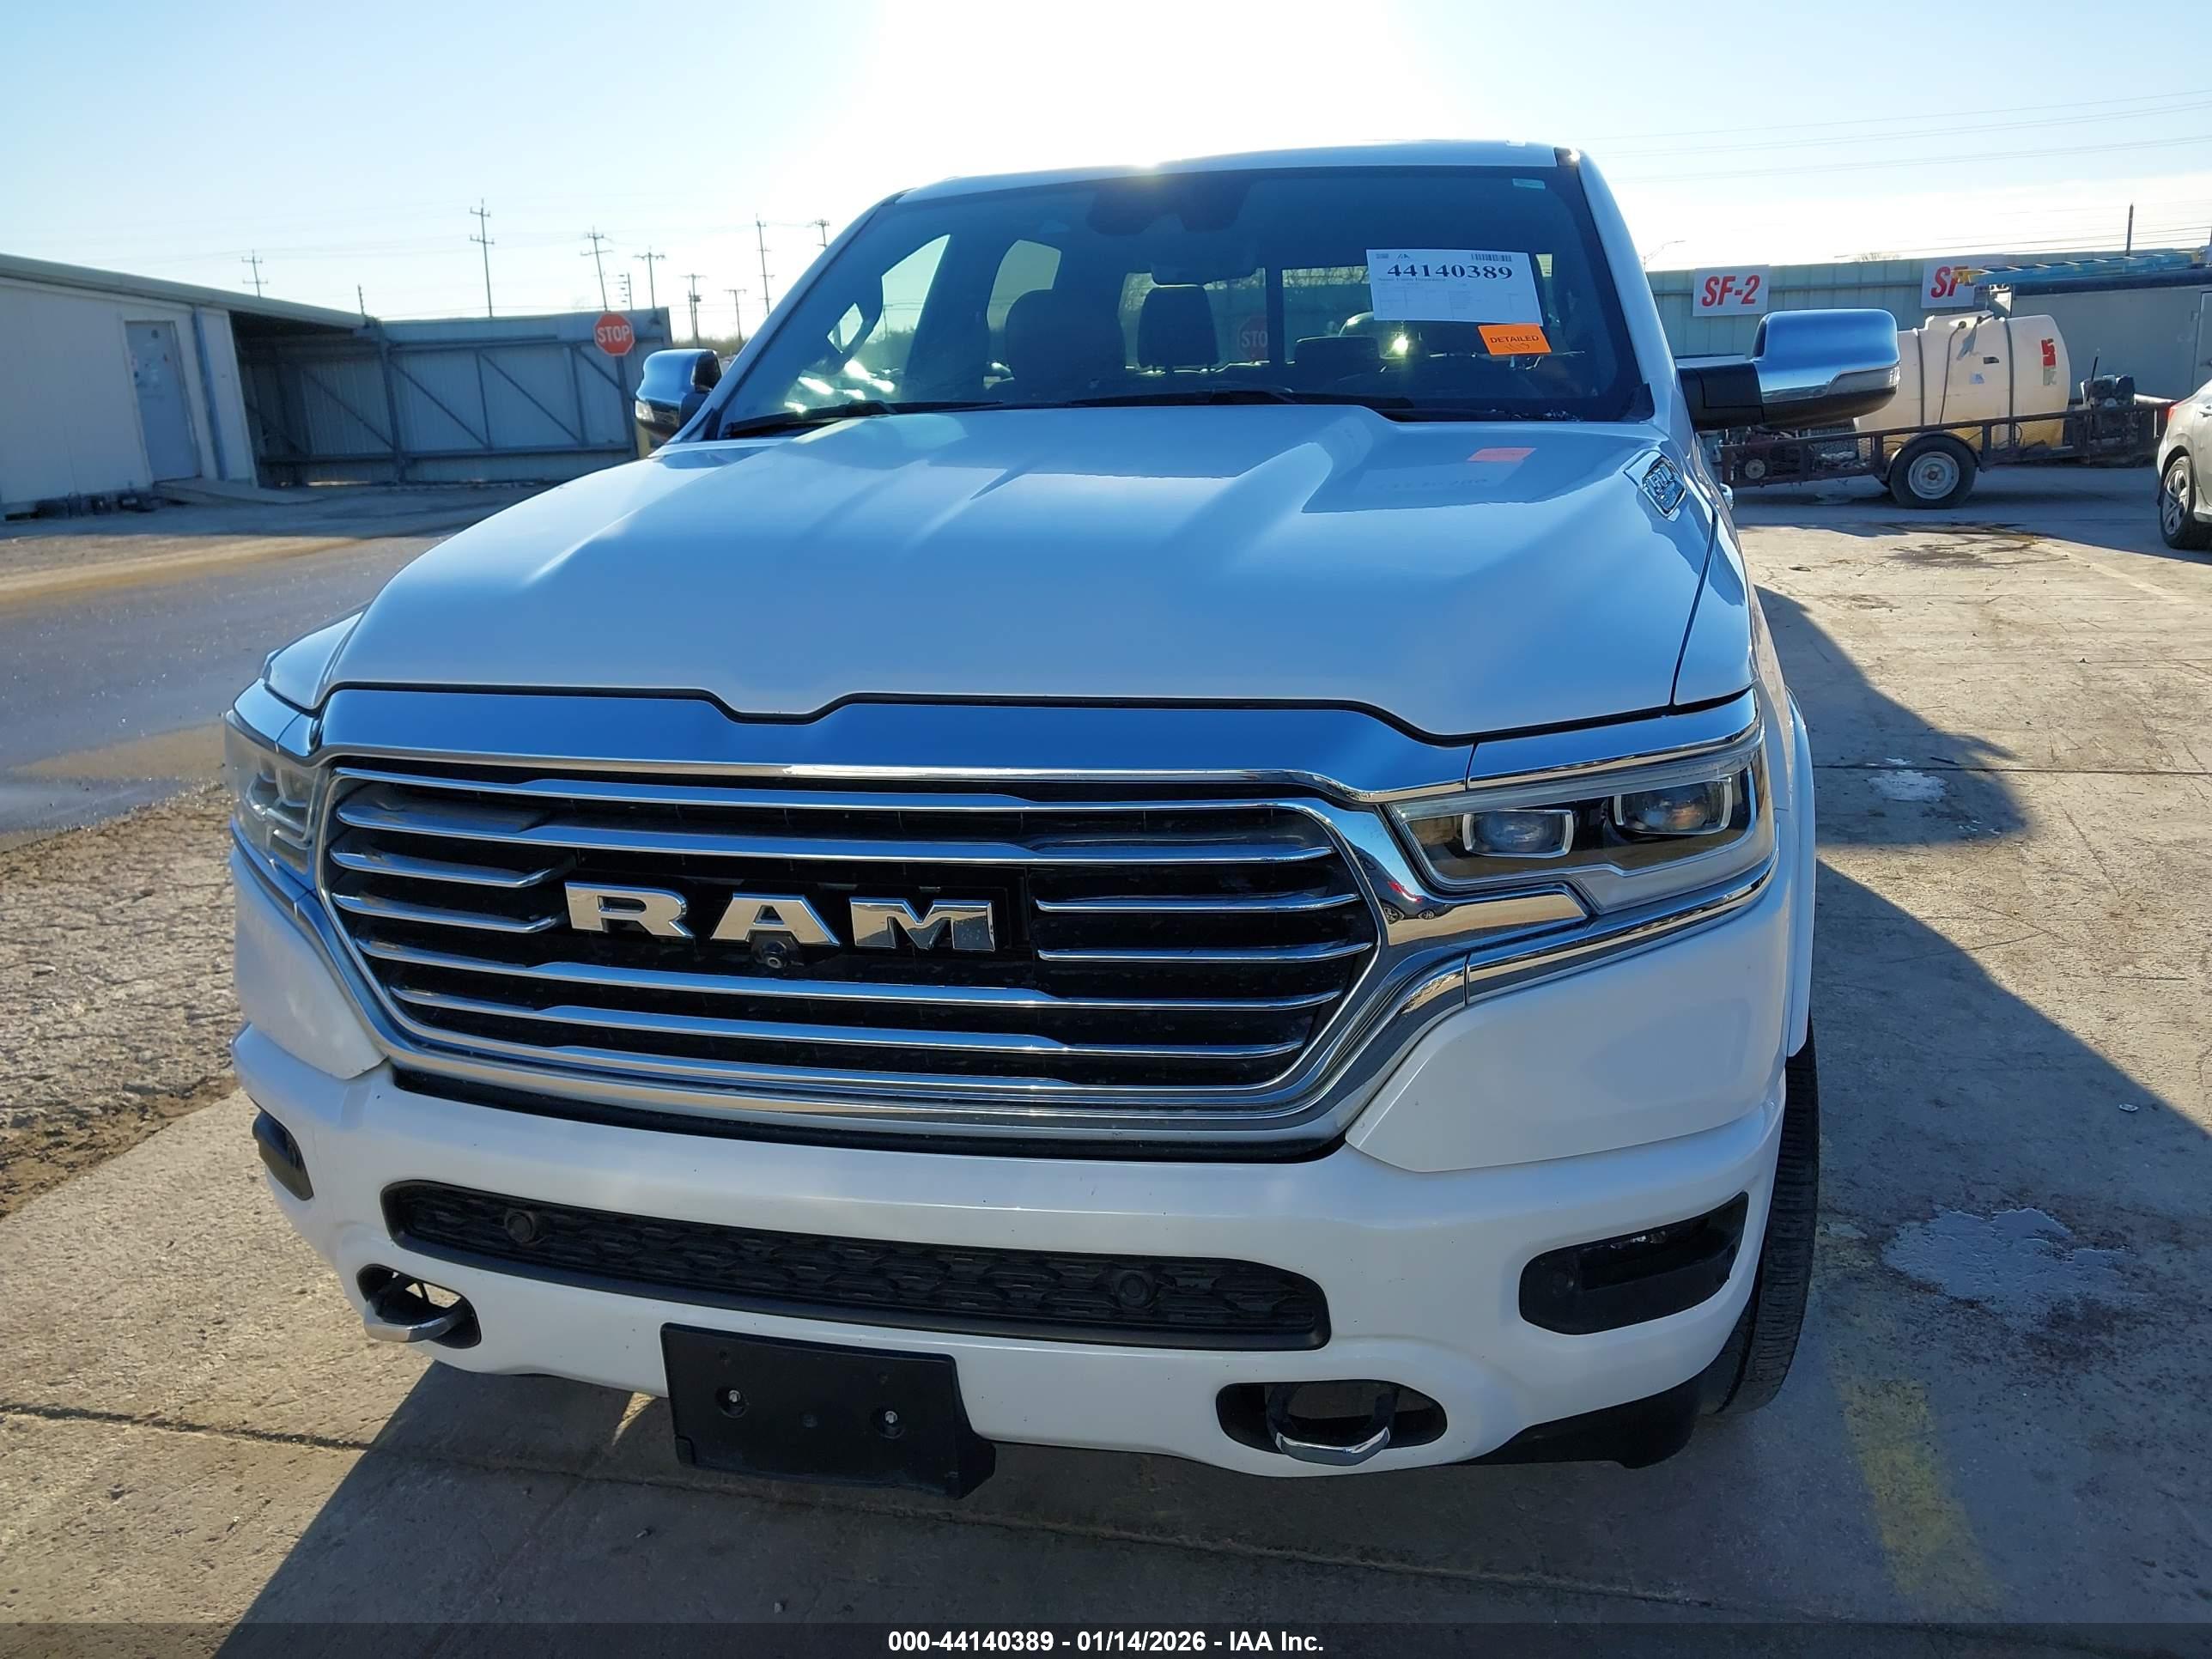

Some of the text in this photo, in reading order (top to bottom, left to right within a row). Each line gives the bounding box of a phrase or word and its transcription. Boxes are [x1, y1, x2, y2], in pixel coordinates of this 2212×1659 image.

[1387, 264, 1513, 279] 44140389
[1702, 275, 1760, 307] SF-2
[597, 325, 630, 343] STOP
[1242, 331, 1269, 348] STO
[1490, 335, 1540, 343] DETAILED
[564, 881, 997, 952] RAM
